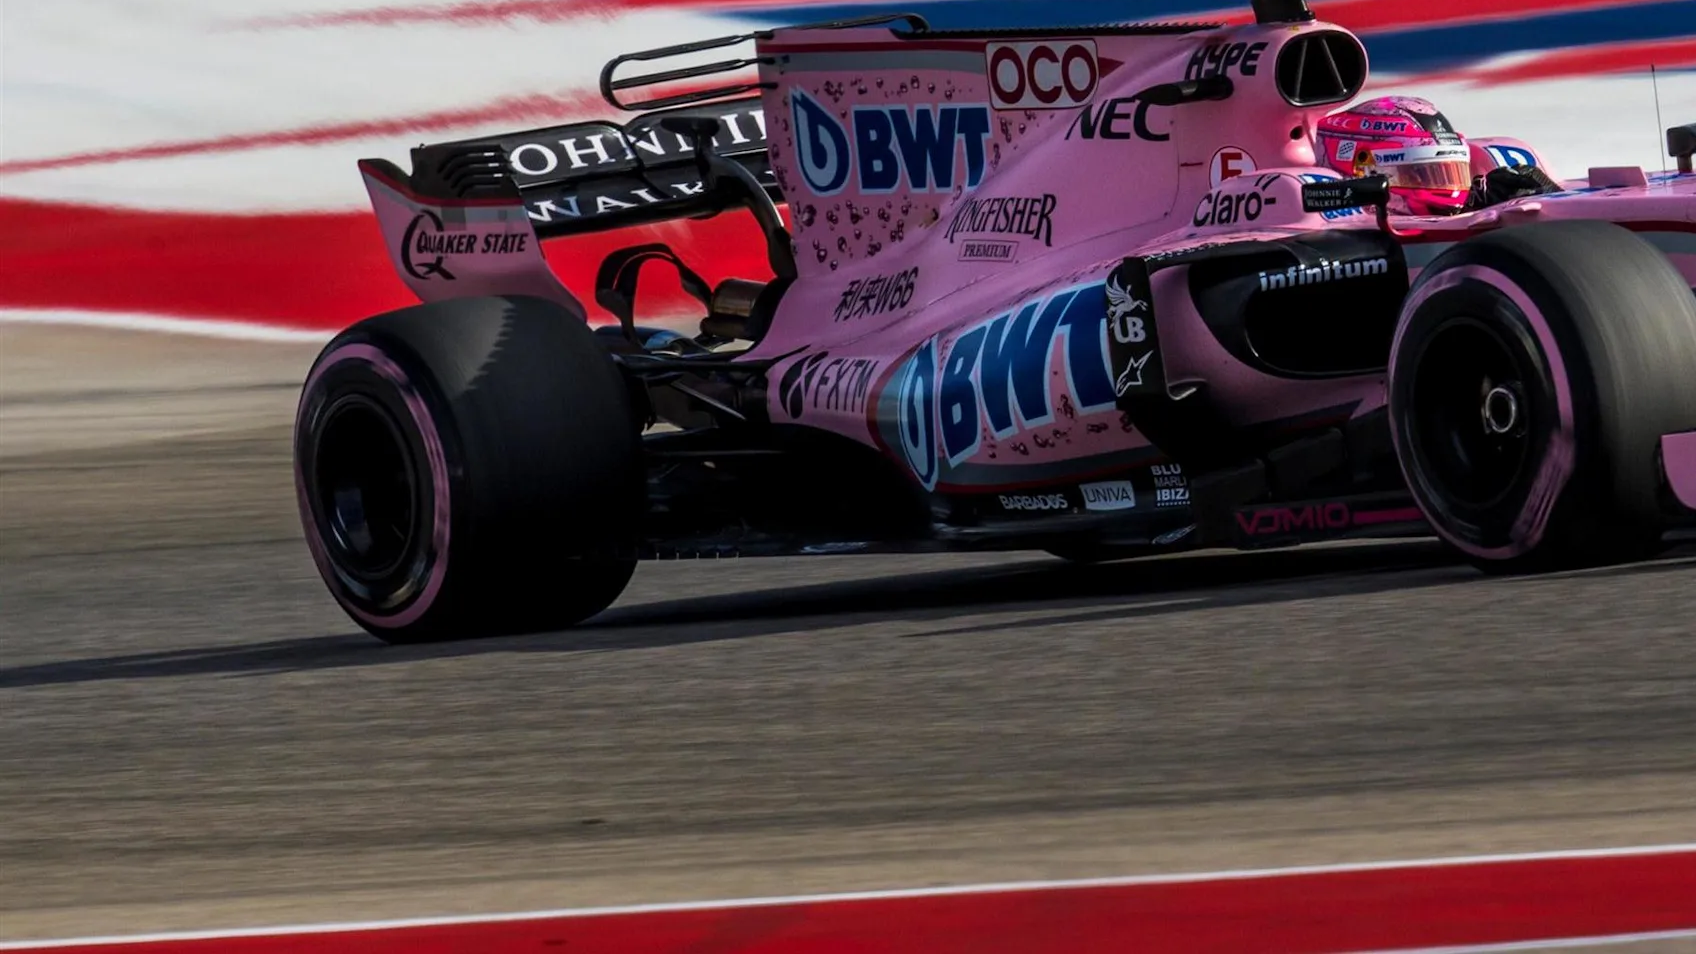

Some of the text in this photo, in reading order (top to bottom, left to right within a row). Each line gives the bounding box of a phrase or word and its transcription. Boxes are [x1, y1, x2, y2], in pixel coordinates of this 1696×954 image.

[989, 45, 1098, 104] OCO
[1184, 42, 1269, 80] HYPE
[1064, 97, 1170, 142] NEC
[1373, 120, 1407, 132] BWT
[852, 104, 992, 195] BWT
[1383, 152, 1405, 163] BWT
[1305, 188, 1341, 199] JOHNNIE
[943, 193, 1057, 248] KINGFISHER
[416, 230, 530, 255] QUAKER STATE
[963, 243, 1012, 259] PREMIUM
[1258, 257, 1388, 292] infinitum
[813, 357, 879, 414] FXTM
[939, 277, 1117, 470] BWT
[1150, 463, 1183, 476] BLU
[999, 493, 1069, 511] BARBADOS
[1083, 486, 1132, 503] UNIVA
